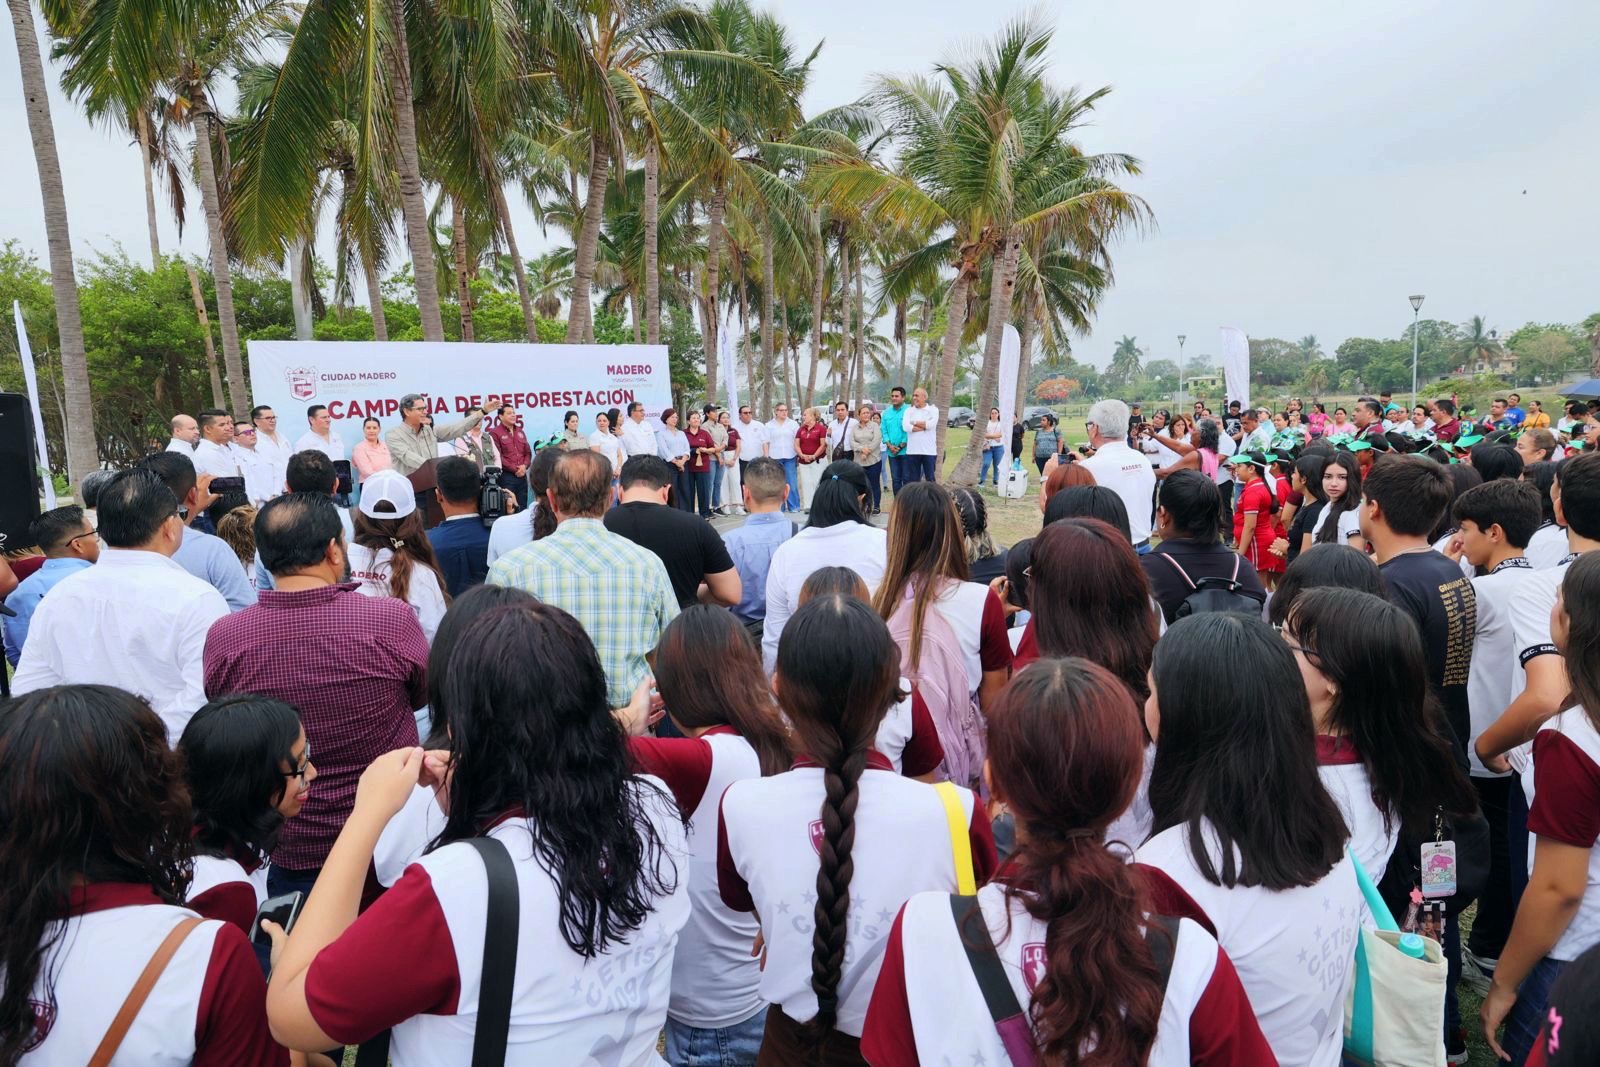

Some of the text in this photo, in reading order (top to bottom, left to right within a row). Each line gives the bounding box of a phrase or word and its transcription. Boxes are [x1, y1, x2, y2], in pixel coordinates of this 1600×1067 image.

[607, 365, 652, 375] MADERO
[321, 372, 397, 381] CIUDAD MADERO
[327, 393, 449, 419] CAMPÑA
[455, 395, 482, 413] DE
[484, 414, 525, 432] 205
[350, 570, 387, 580] ADERO
